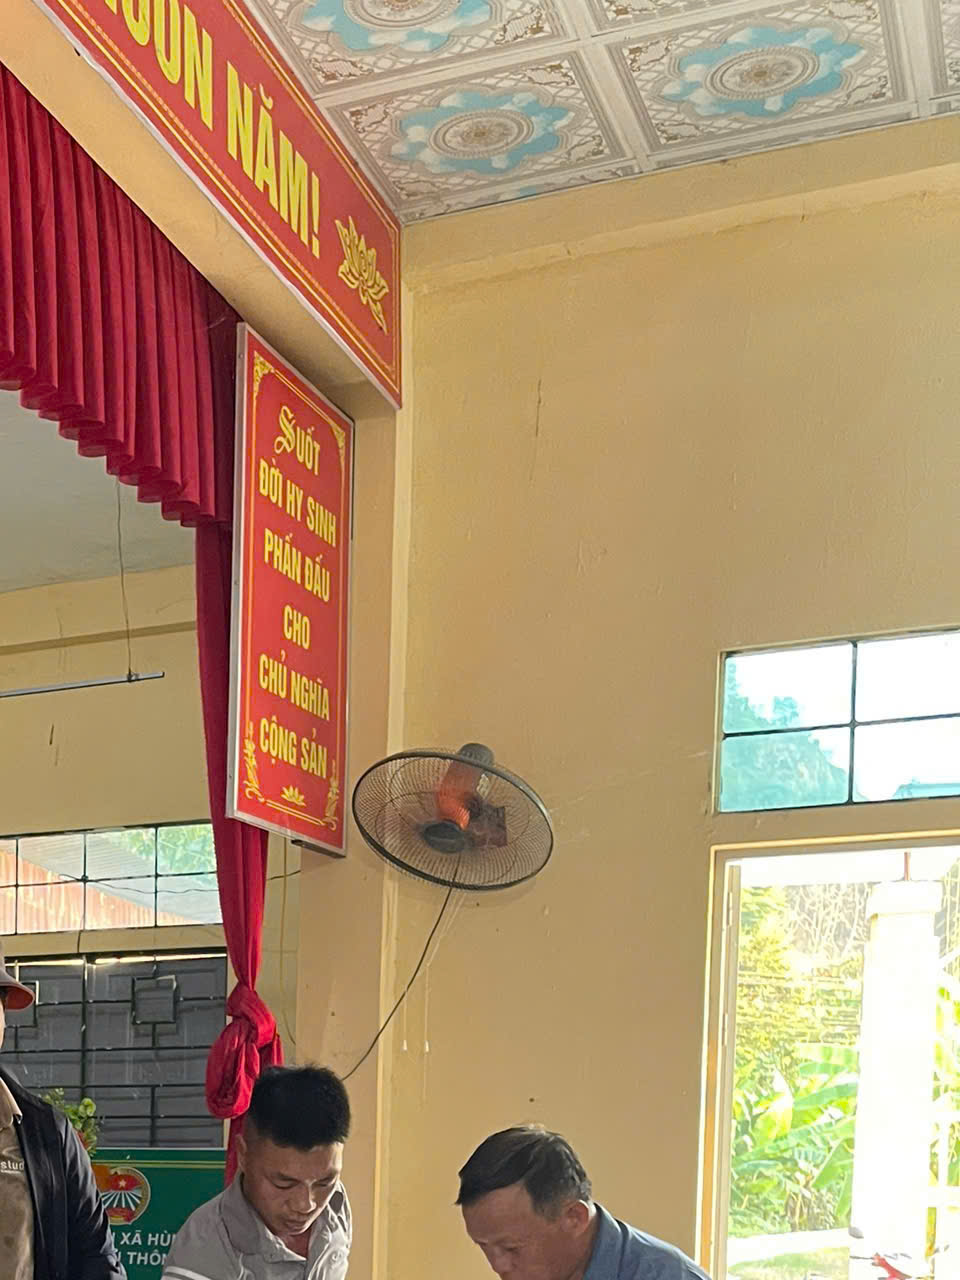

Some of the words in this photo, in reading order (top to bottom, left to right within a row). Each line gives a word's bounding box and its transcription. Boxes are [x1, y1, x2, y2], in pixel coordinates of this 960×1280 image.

[227, 60, 320, 259] NĂM!
[273, 405, 320, 476] SUỐT
[259, 457, 283, 509] ĐỜI
[286, 479, 304, 522] HY
[306, 496, 337, 548] SINH
[264, 527, 302, 585] PHẤN
[304, 554, 331, 602] ĐẤU
[283, 604, 311, 650] CHO
[258, 649, 288, 699] CHỦ
[290, 669, 330, 721] NGHĨA
[259, 714, 297, 767] CỘNG
[300, 727, 328, 779] SẢN
[120, 1230, 142, 1245] XÃ
